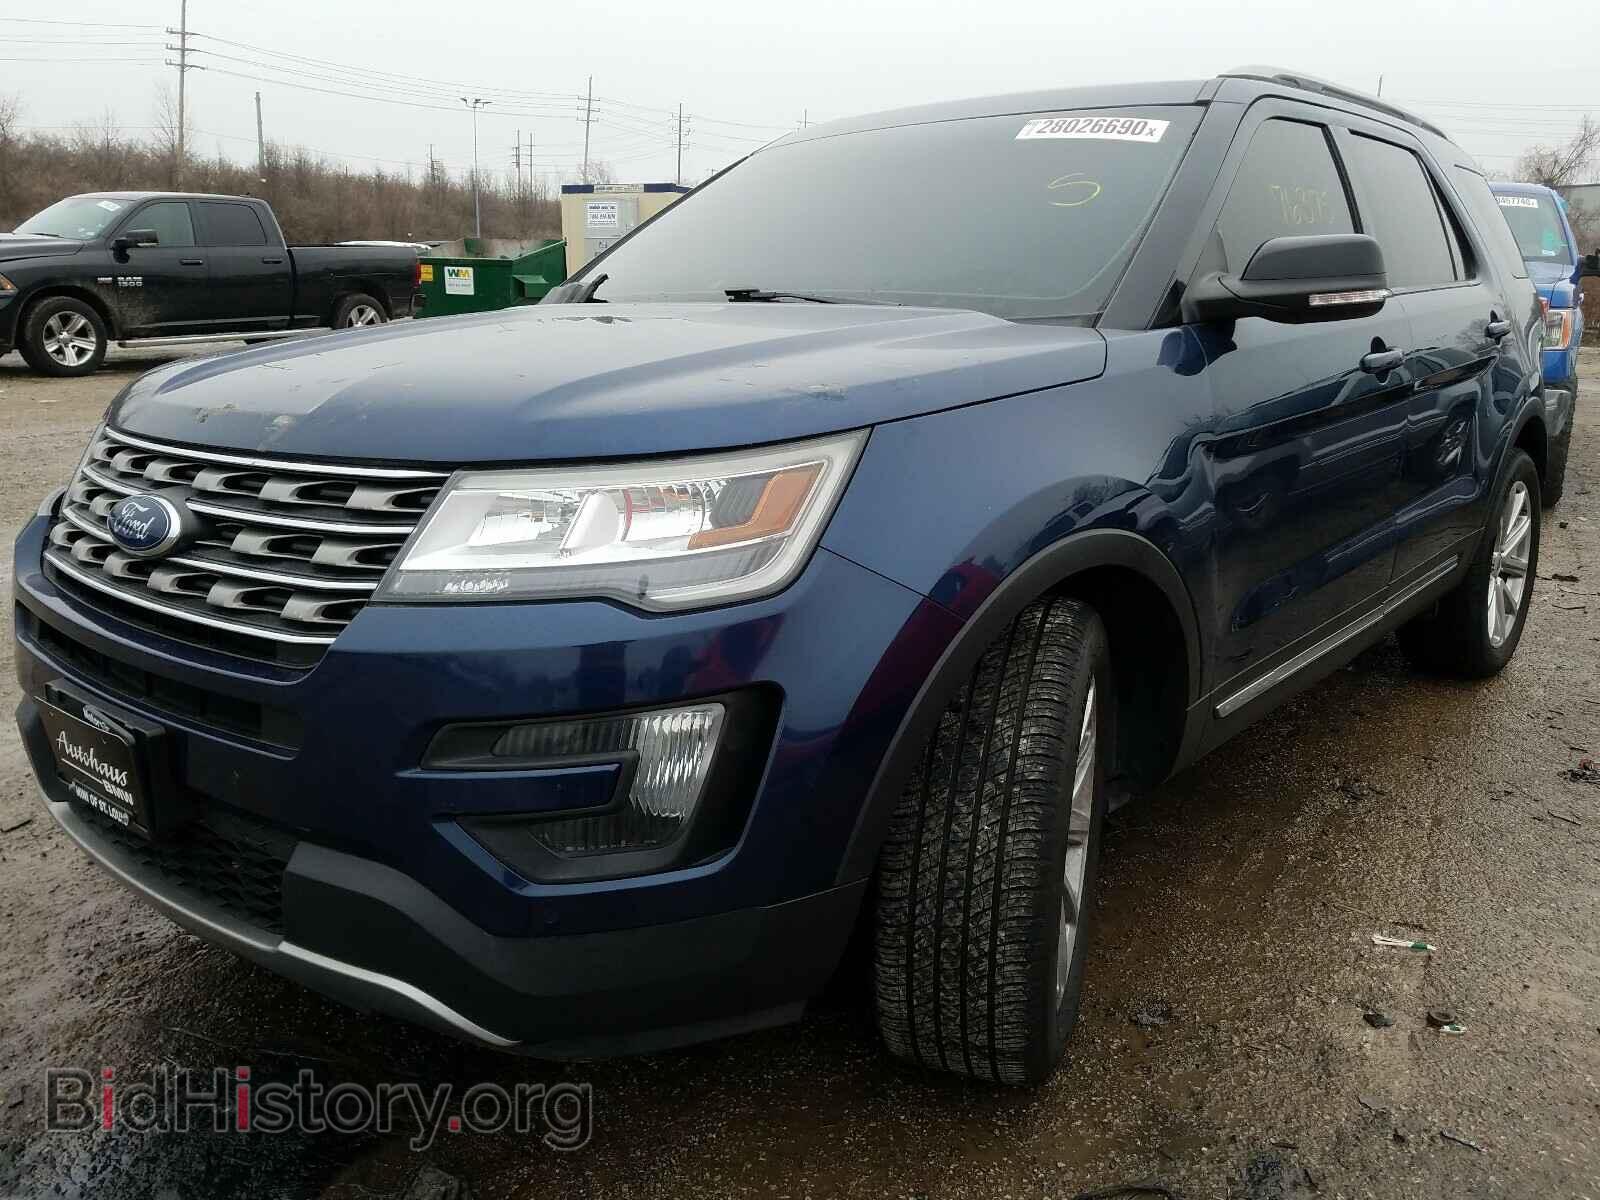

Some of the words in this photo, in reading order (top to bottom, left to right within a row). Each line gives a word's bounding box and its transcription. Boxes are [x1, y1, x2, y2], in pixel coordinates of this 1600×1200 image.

[113, 501, 155, 540] Ford
[56, 730, 128, 787] Autohaus
[102, 779, 134, 806] BMW
